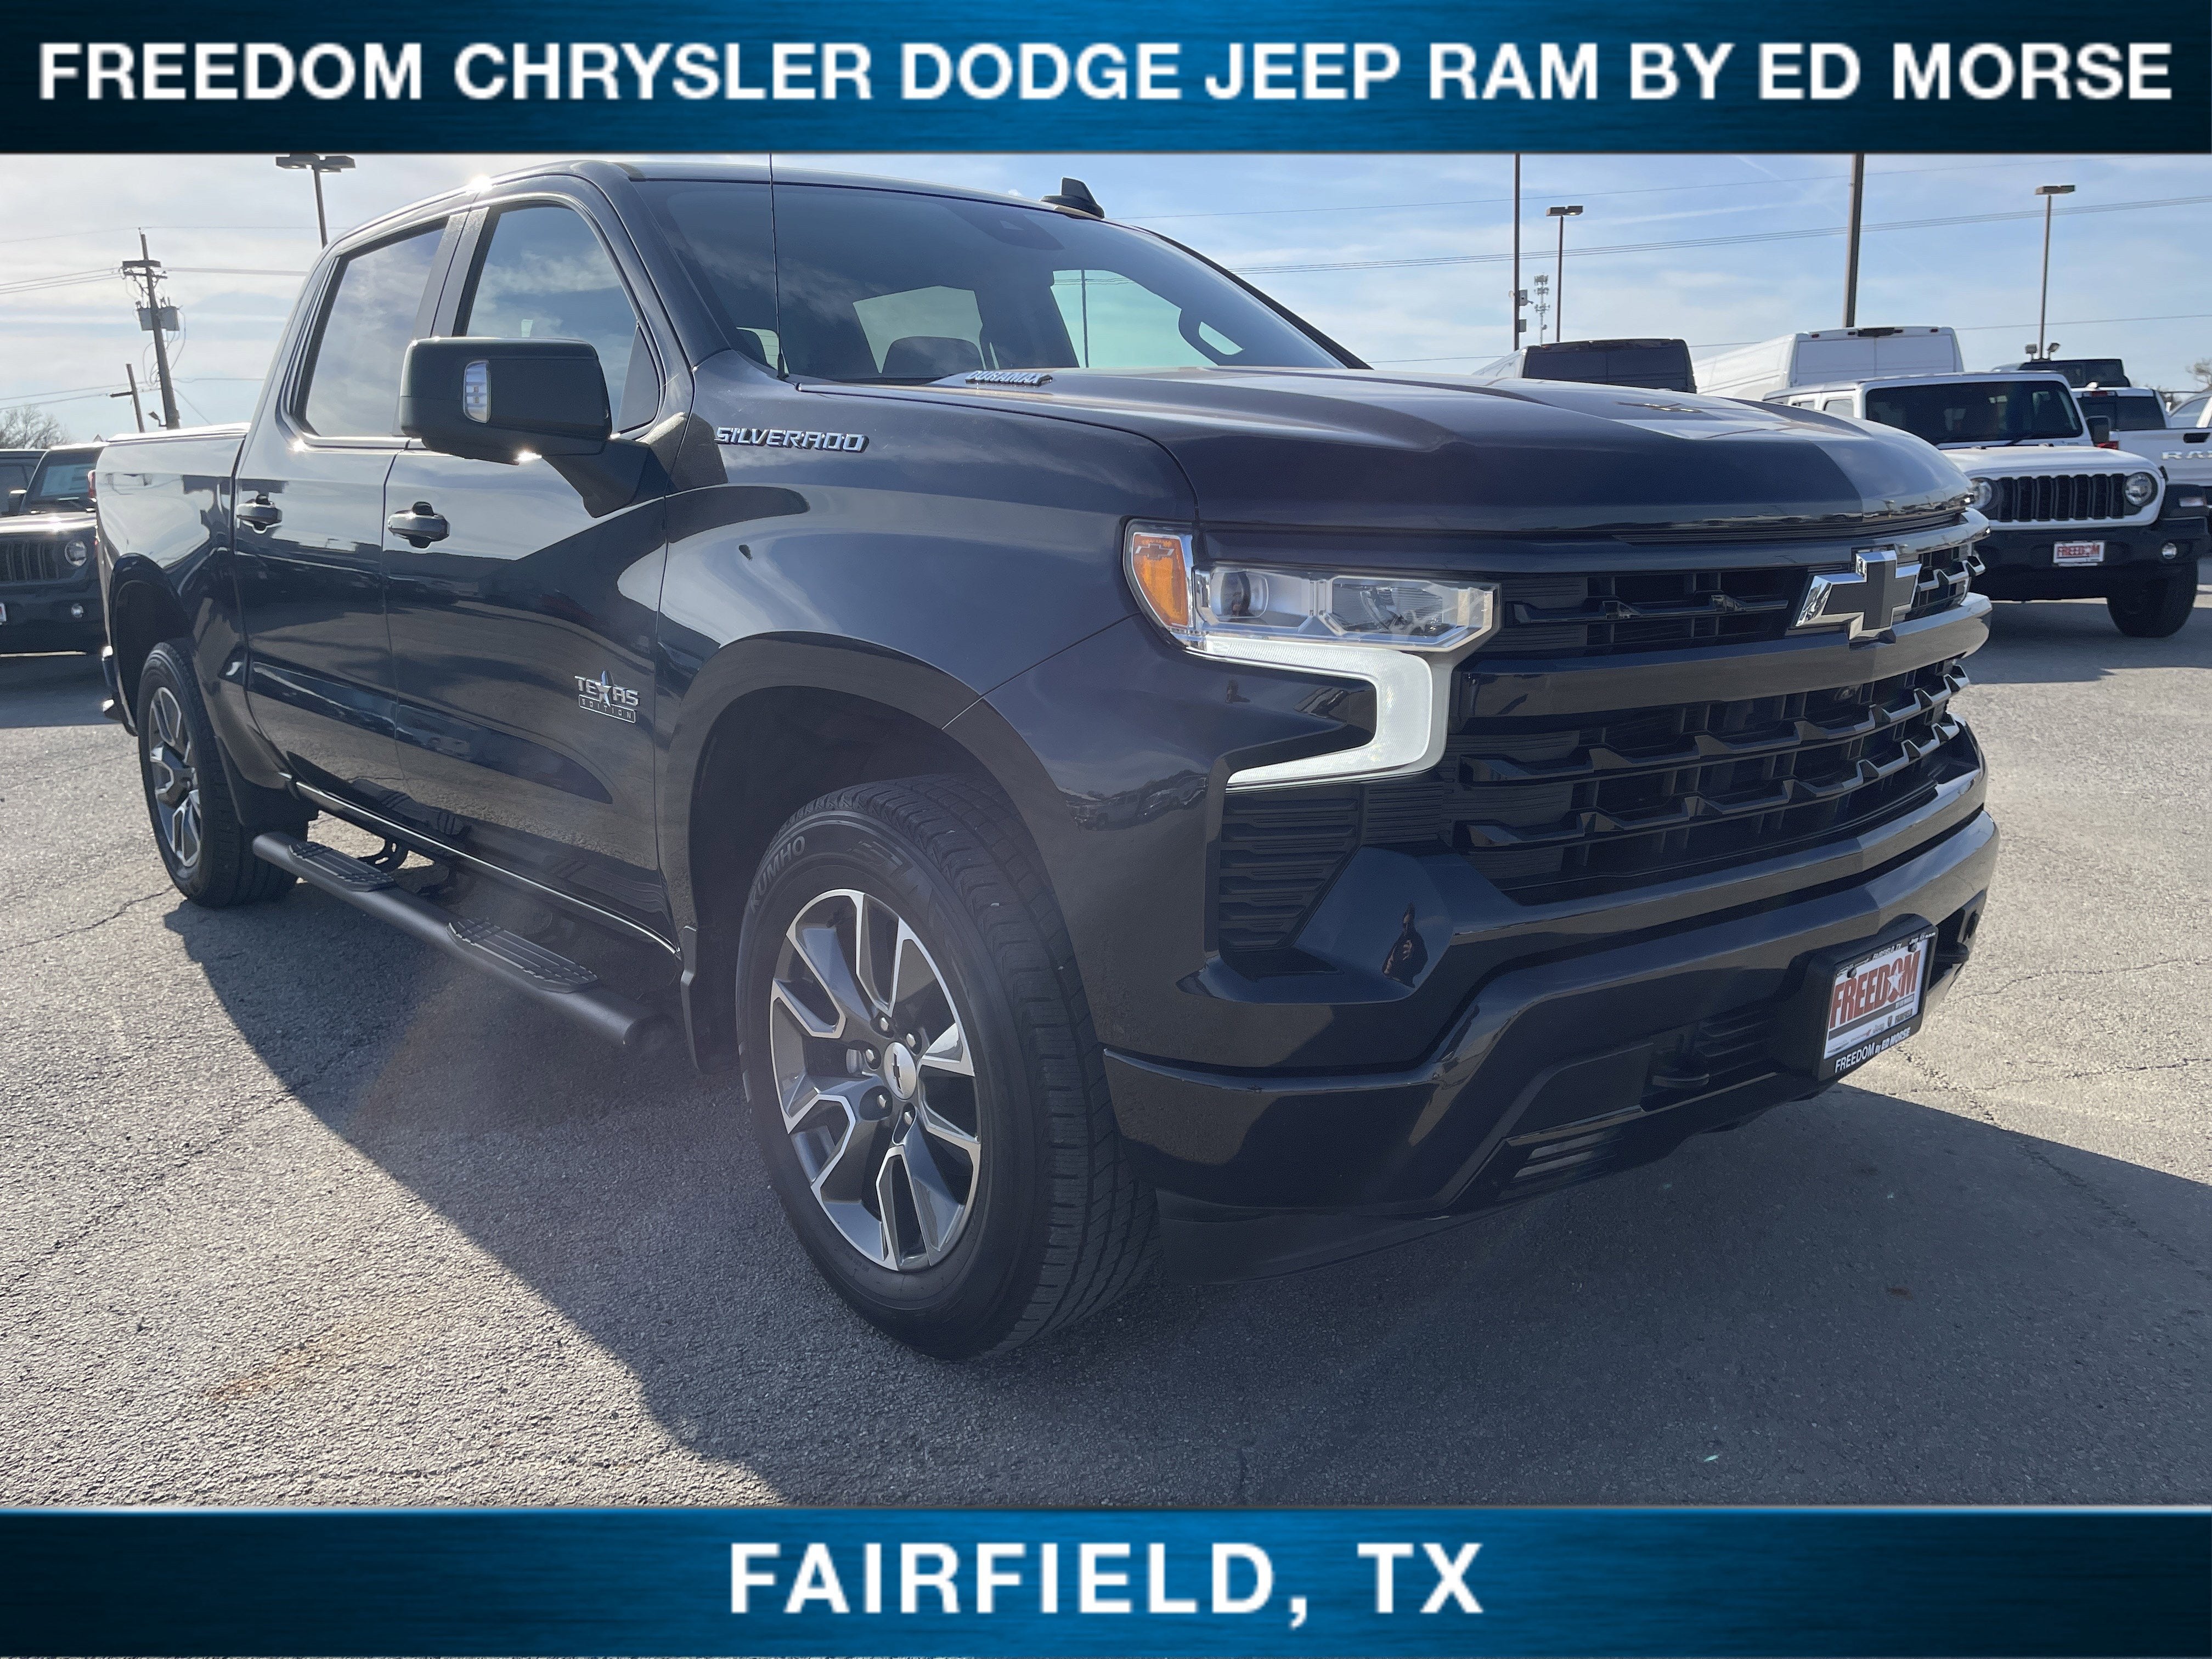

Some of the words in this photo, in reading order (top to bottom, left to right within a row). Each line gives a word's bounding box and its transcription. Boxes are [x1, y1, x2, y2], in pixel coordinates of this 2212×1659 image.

[965, 370, 1049, 386] DURAMAX
[714, 426, 870, 453] SILVERADO
[2162, 450, 2212, 460] RA
[582, 698, 632, 719] EDITION
[750, 835, 806, 915] KUMHO
[1829, 950, 1921, 1029] FREEDOM
[1835, 1042, 1875, 1073] FREEDOM
[1881, 1039, 1890, 1051] ED
[1889, 1026, 1911, 1047] MORSE
